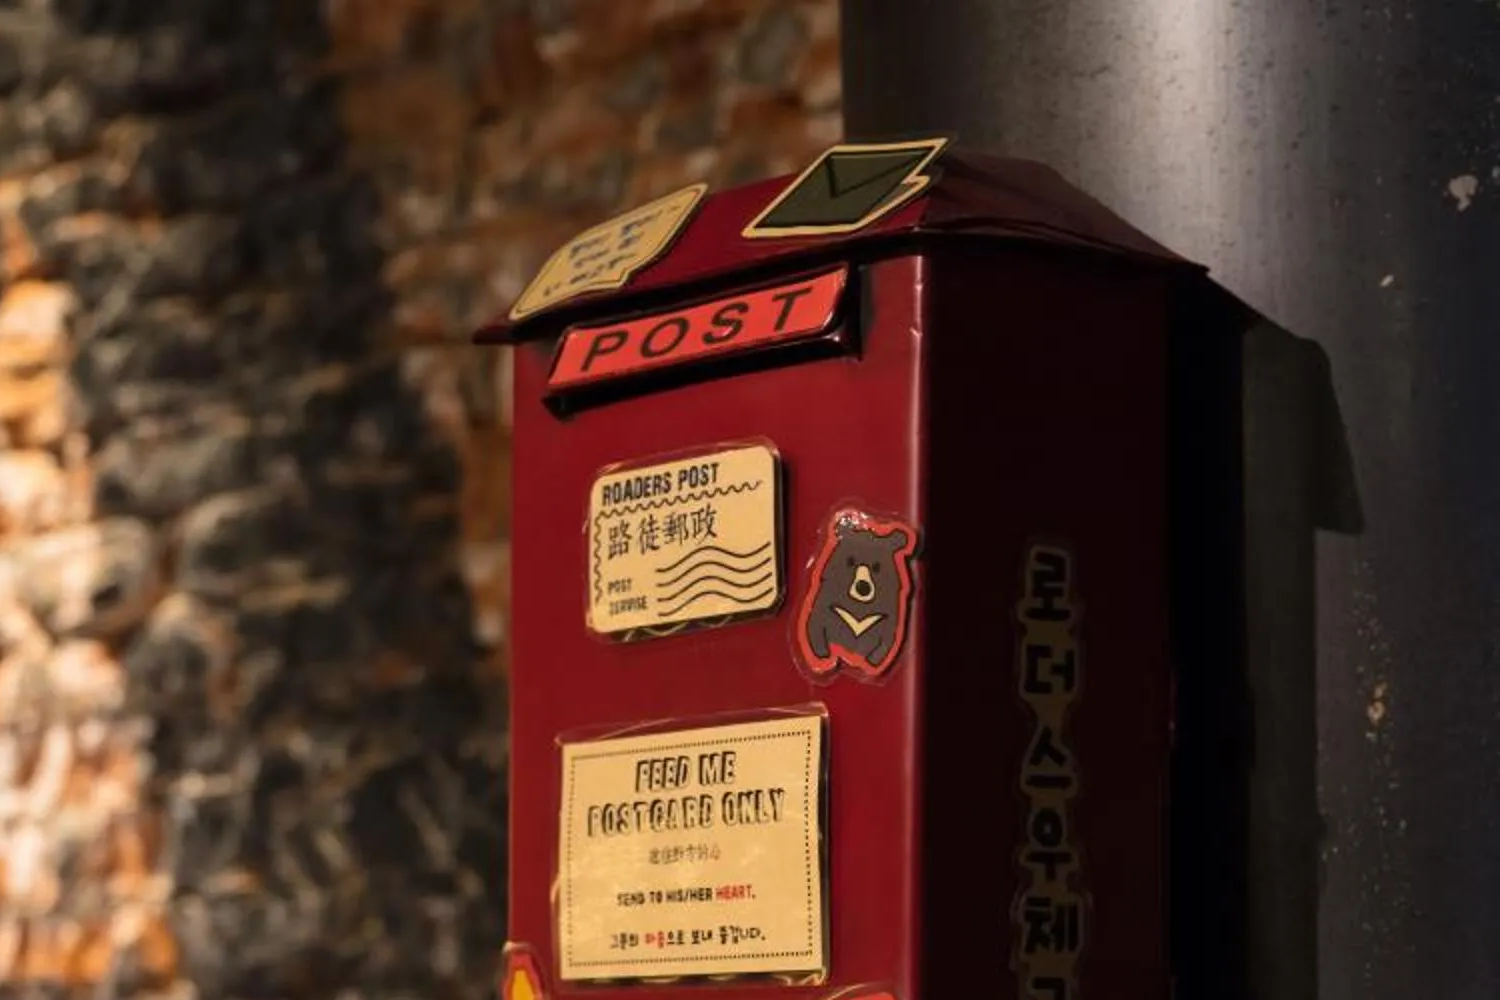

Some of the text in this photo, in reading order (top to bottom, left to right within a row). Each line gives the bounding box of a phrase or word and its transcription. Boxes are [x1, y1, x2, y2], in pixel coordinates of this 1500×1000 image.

[581, 287, 812, 373] POST
[602, 462, 720, 506] ROADERS POST
[607, 504, 718, 560] 路徒郵政
[607, 578, 632, 595] POST
[635, 751, 737, 793] FEED ME
[587, 787, 785, 838] POSTCARD ONLY
[616, 883, 757, 907] SEND TO HIS/HER HEART.
